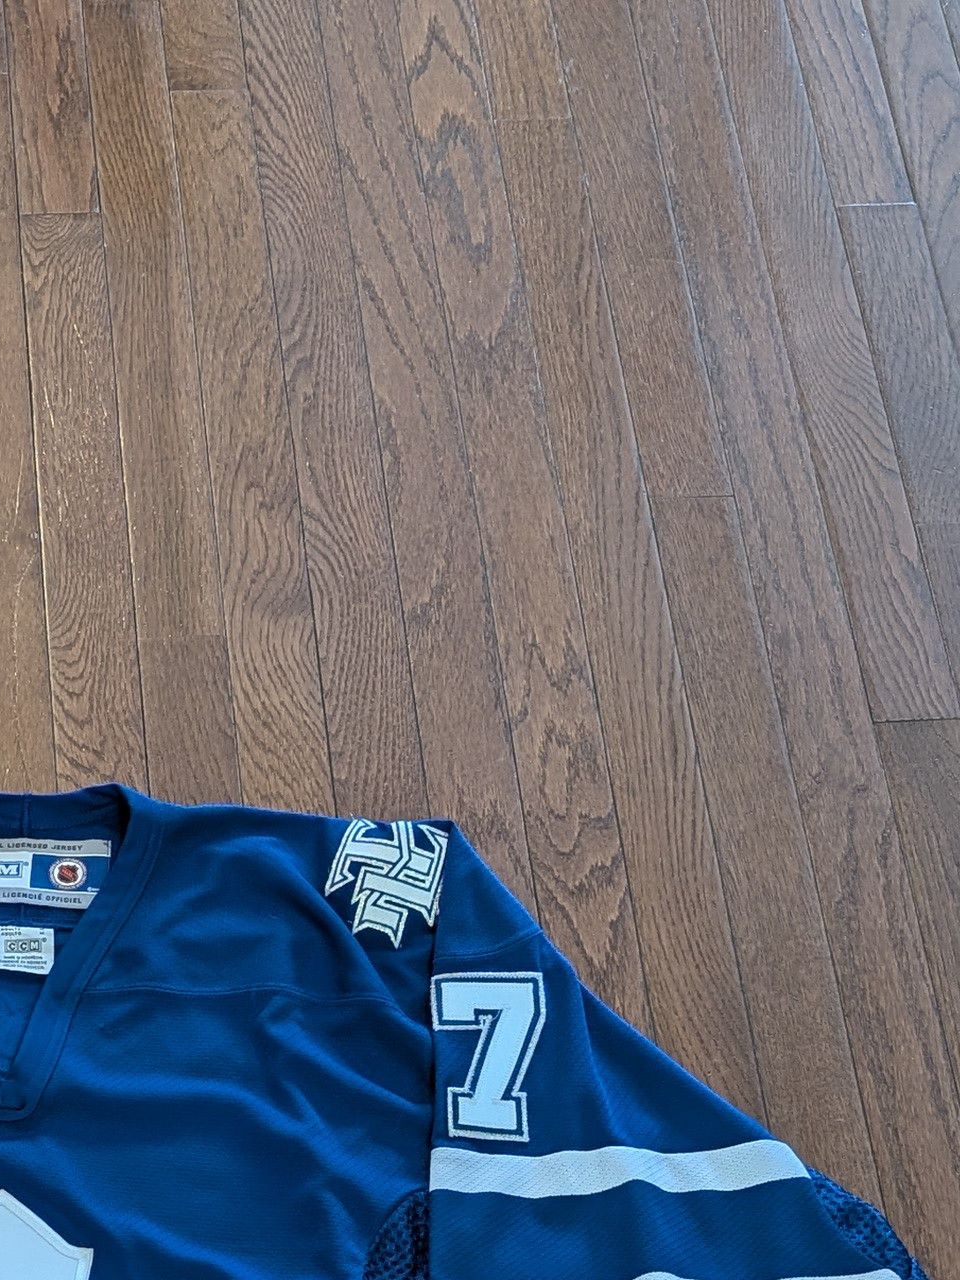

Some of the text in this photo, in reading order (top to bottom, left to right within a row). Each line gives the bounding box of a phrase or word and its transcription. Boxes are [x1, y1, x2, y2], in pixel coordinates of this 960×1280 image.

[45, 895, 82, 904] OFFICIEL
[8, 942, 40, 951] CCM
[431, 971, 546, 1142] 7
